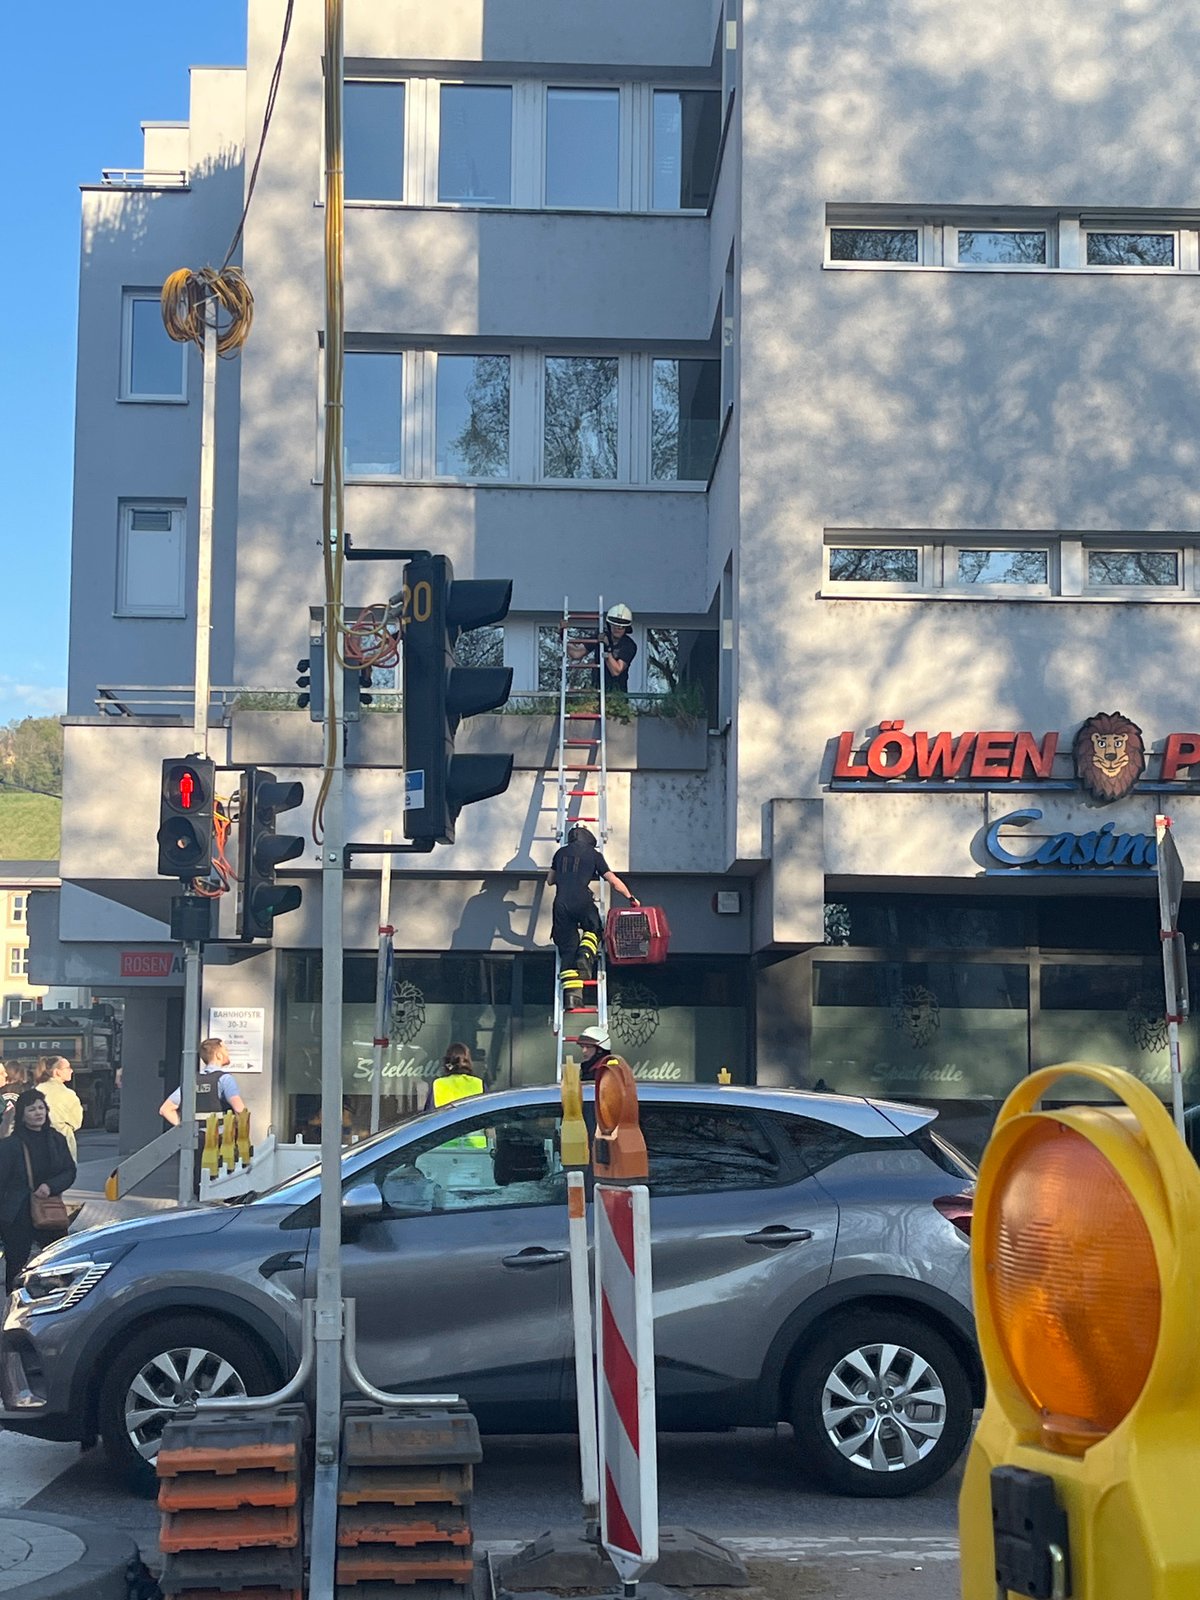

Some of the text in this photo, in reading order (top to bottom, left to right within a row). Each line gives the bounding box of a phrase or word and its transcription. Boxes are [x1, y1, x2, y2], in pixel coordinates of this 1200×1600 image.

[832, 719, 1059, 779] LÖWEN
[124, 956, 168, 973] ROSEN
[353, 1057, 443, 1081] Sielhall
